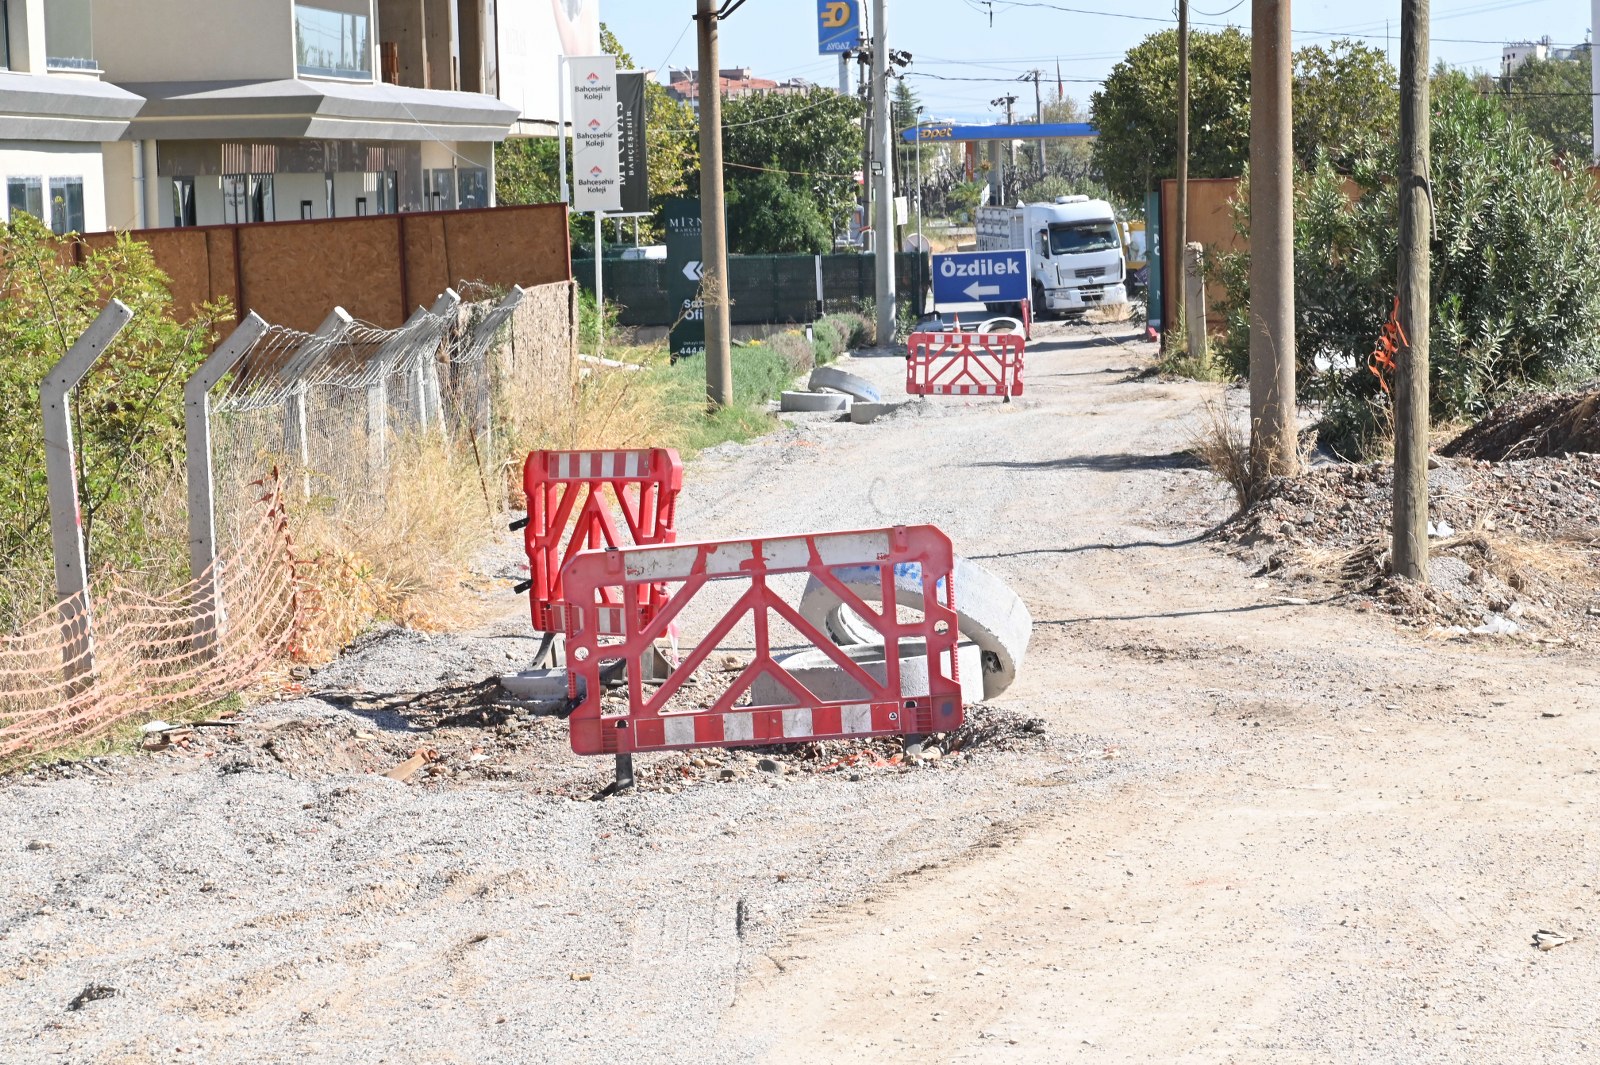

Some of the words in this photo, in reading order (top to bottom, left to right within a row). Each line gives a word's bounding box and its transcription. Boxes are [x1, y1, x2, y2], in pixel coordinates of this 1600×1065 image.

[826, 41, 850, 50] AYGAZ
[576, 132, 613, 140] Bahçeşehir
[587, 186, 607, 194] Koleji
[940, 257, 1020, 278] Özdilek
[684, 299, 704, 309] Sat
[684, 309, 703, 320] Ofi
